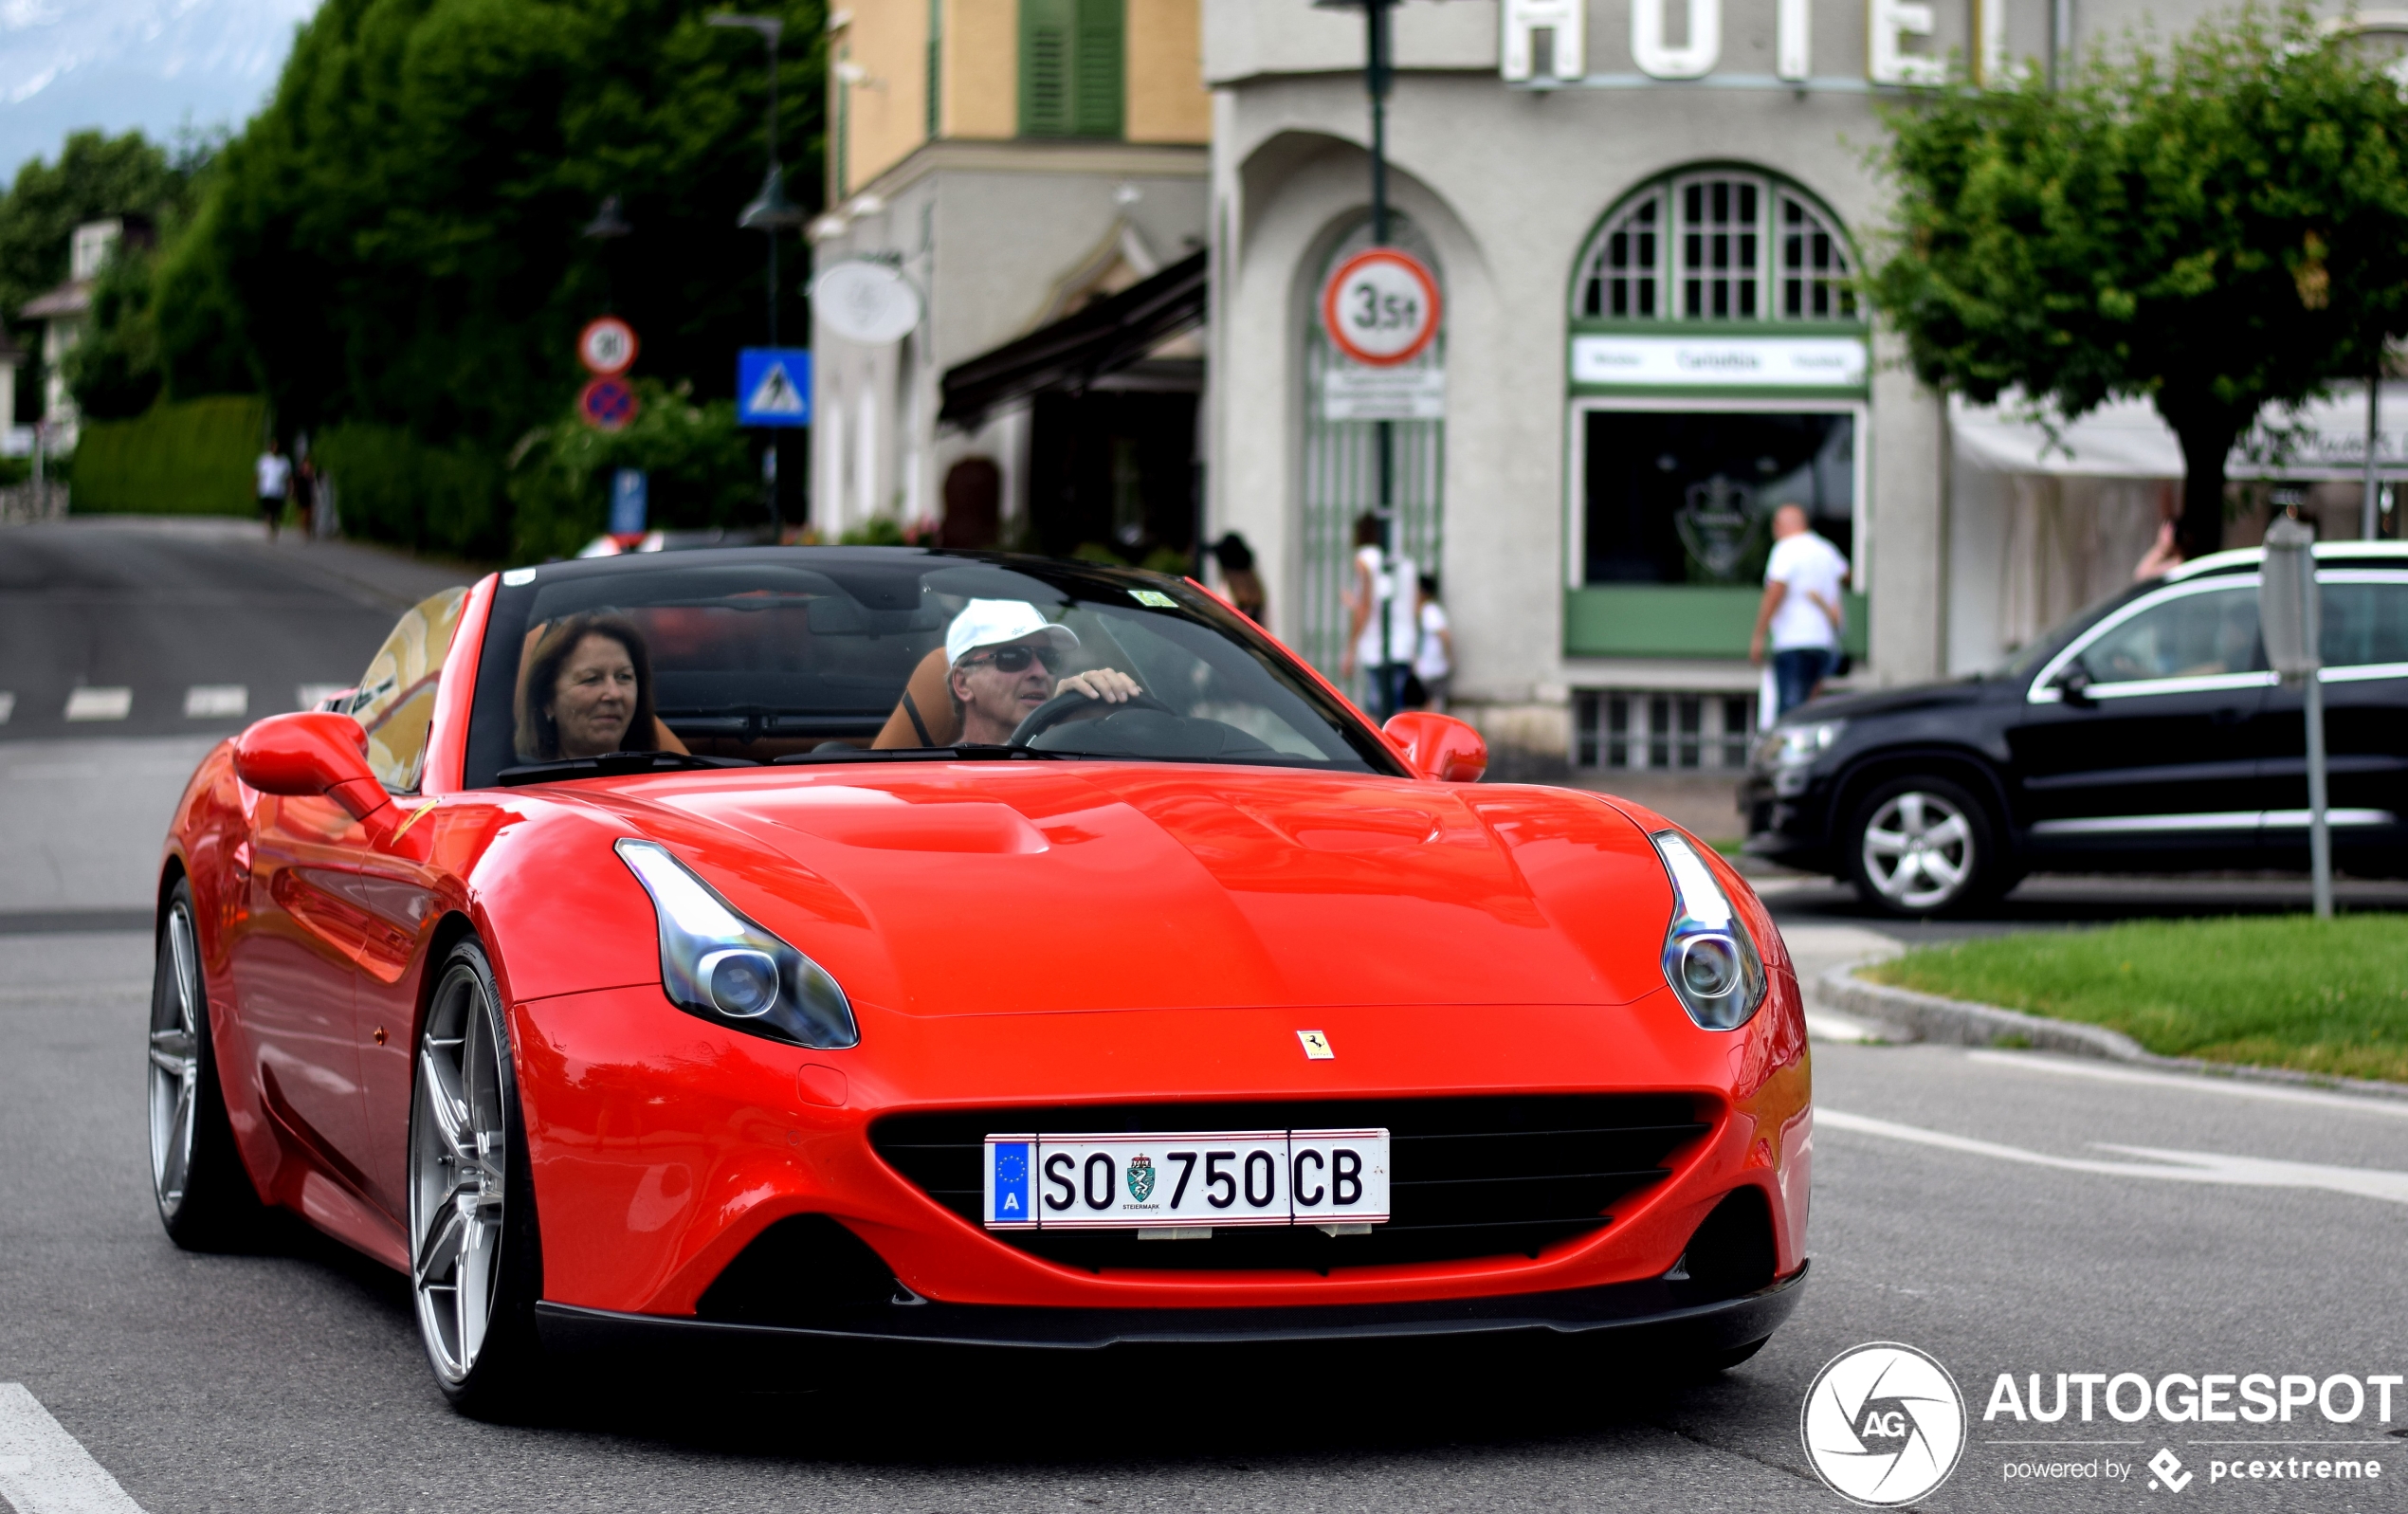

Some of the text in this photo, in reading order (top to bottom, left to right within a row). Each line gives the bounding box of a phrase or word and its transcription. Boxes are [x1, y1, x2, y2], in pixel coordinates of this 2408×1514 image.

[487, 976, 509, 1041] Continental
[1003, 1192, 1020, 1211] A
[1044, 1148, 1363, 1212] SO 750 CB
